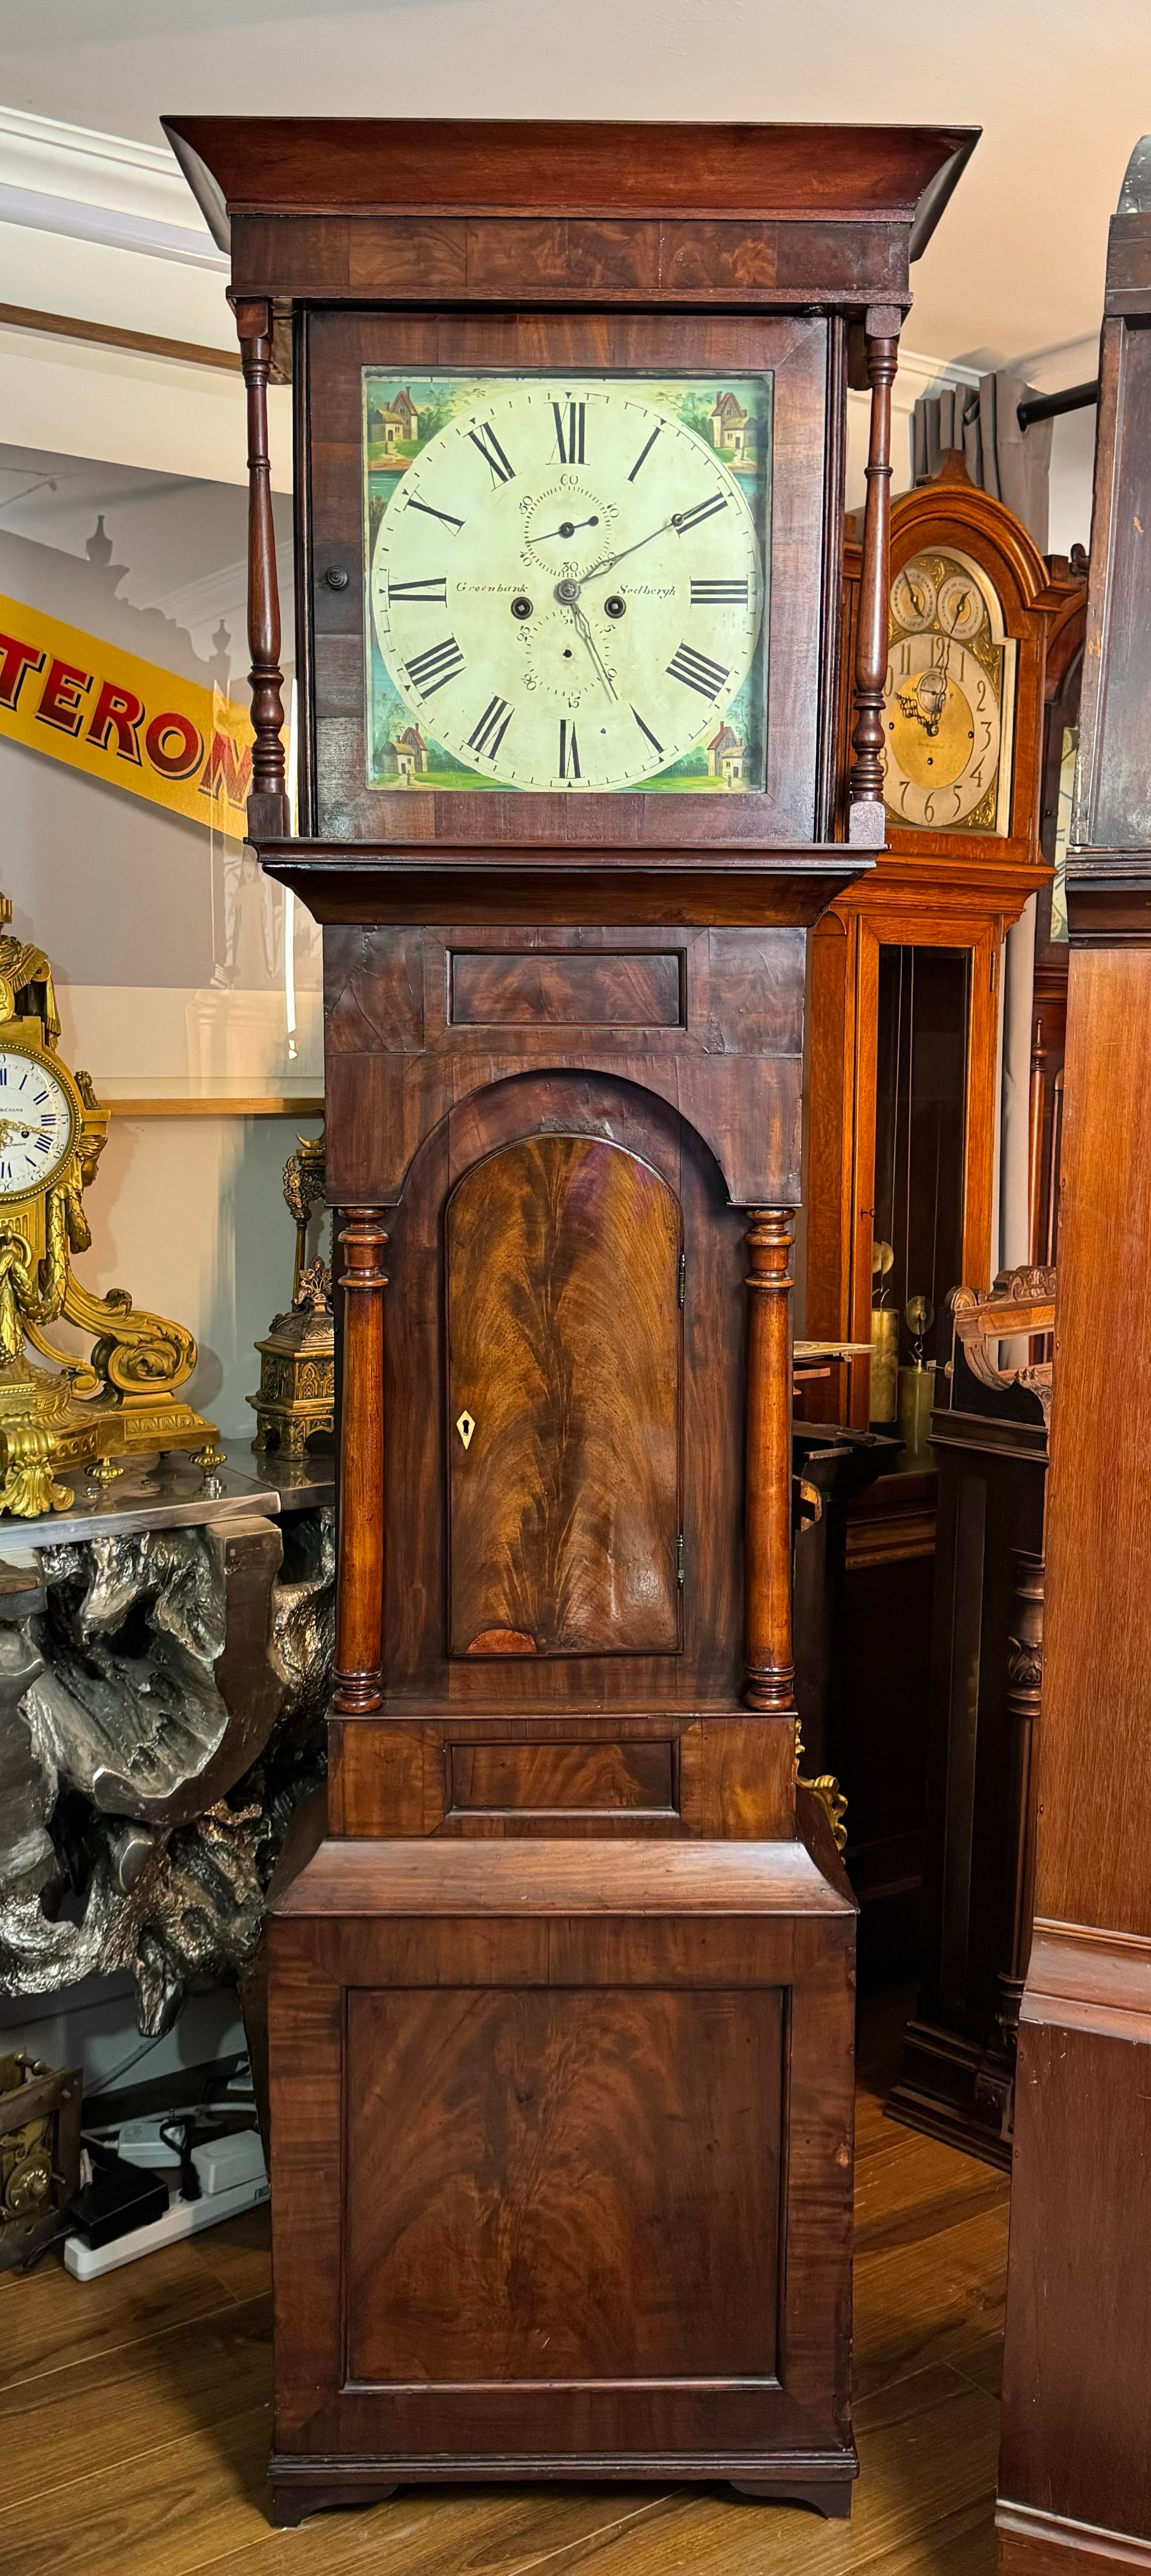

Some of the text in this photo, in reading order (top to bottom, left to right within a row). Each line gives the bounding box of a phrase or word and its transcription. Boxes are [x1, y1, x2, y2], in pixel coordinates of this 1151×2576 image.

[545, 402, 590, 466] XII
[462, 418, 519, 491] XI
[403, 486, 465, 536] X
[561, 561, 579, 573] 30
[388, 568, 447, 608] IX
[456, 582, 528, 592] Greenbank
[617, 584, 676, 599] Sedbergh
[691, 577, 748, 608] III
[401, 633, 467, 700] VIII
[899, 643, 911, 675] 11
[929, 637, 944, 669] 12
[665, 638, 733, 701] IIII
[567, 697, 581, 708] 15
[976, 680, 986, 712] 2
[466, 692, 516, 760] VII
[630, 703, 666, 757] V
[980, 721, 992, 752] 3
[558, 719, 582, 779] VI
[969, 755, 986, 788] 4
[899, 781, 910, 813] 7
[924, 792, 935, 823] 6
[952, 785, 963, 817] 5
